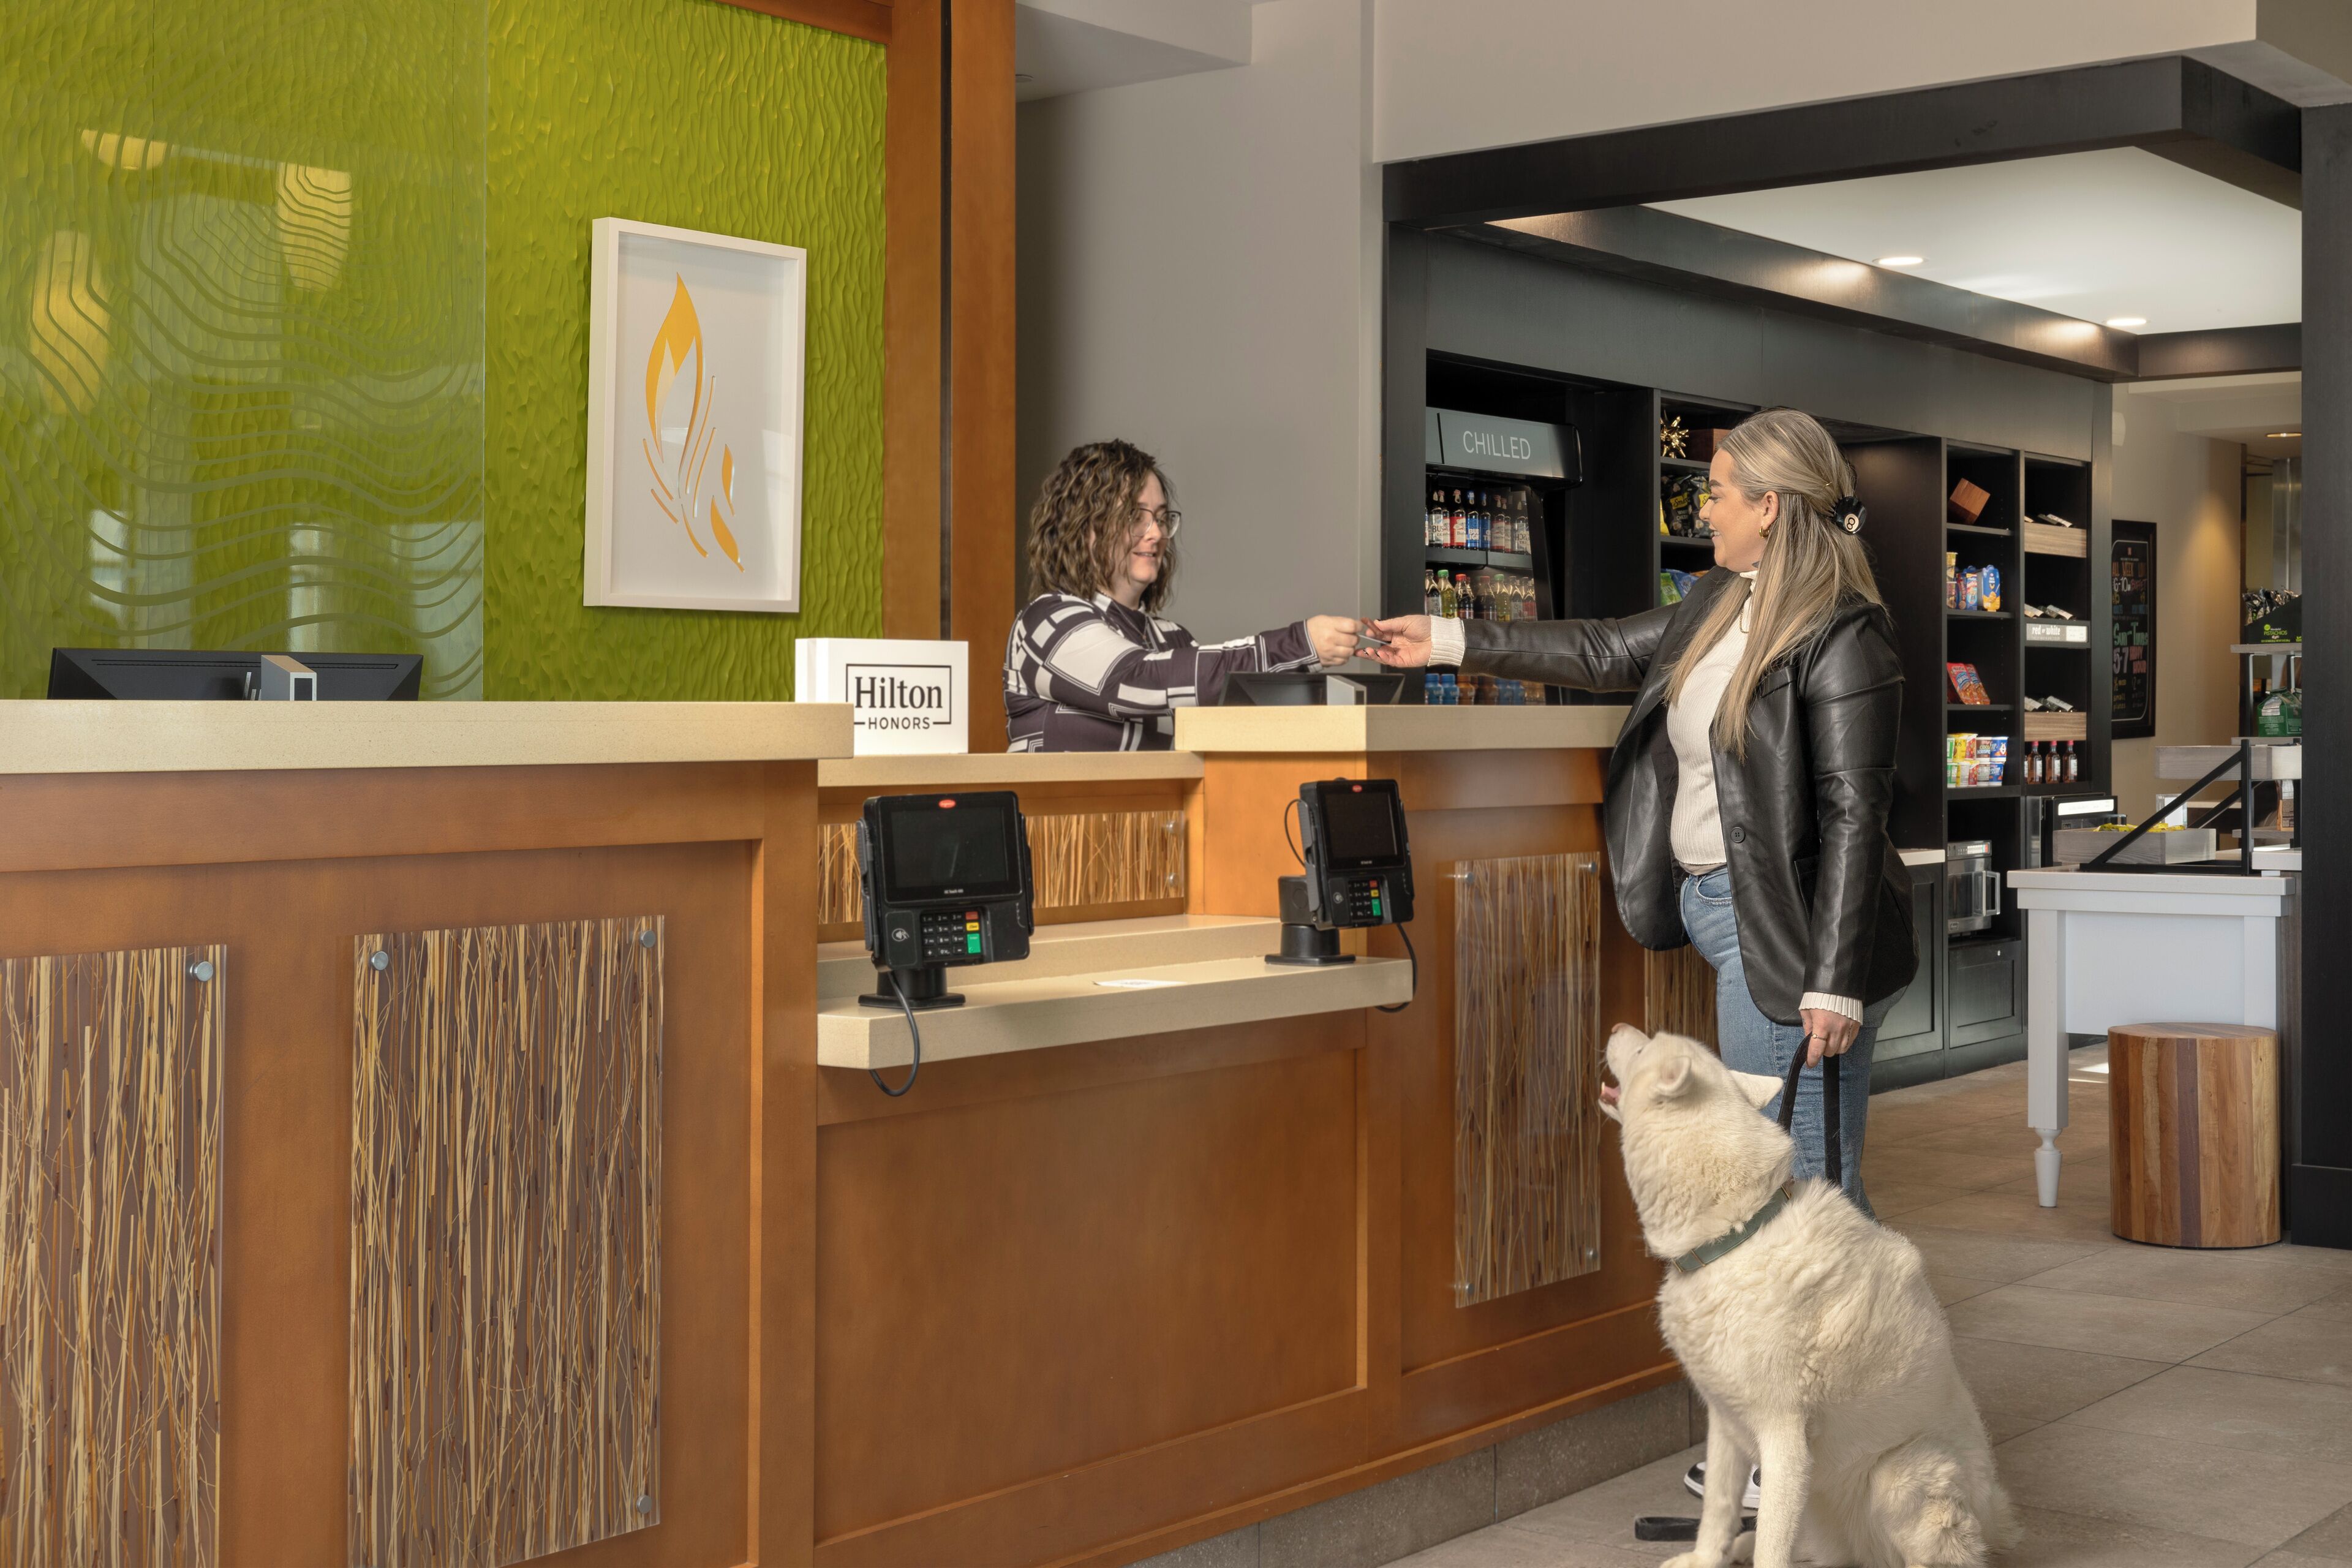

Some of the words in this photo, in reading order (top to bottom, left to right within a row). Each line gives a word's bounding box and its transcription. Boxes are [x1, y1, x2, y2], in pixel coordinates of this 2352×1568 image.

[1463, 431, 1531, 459] CHILLED
[2032, 625, 2041, 635] red
[2046, 625, 2061, 635] white
[854, 676, 943, 709] Hilton
[868, 717, 930, 730] HONORS
